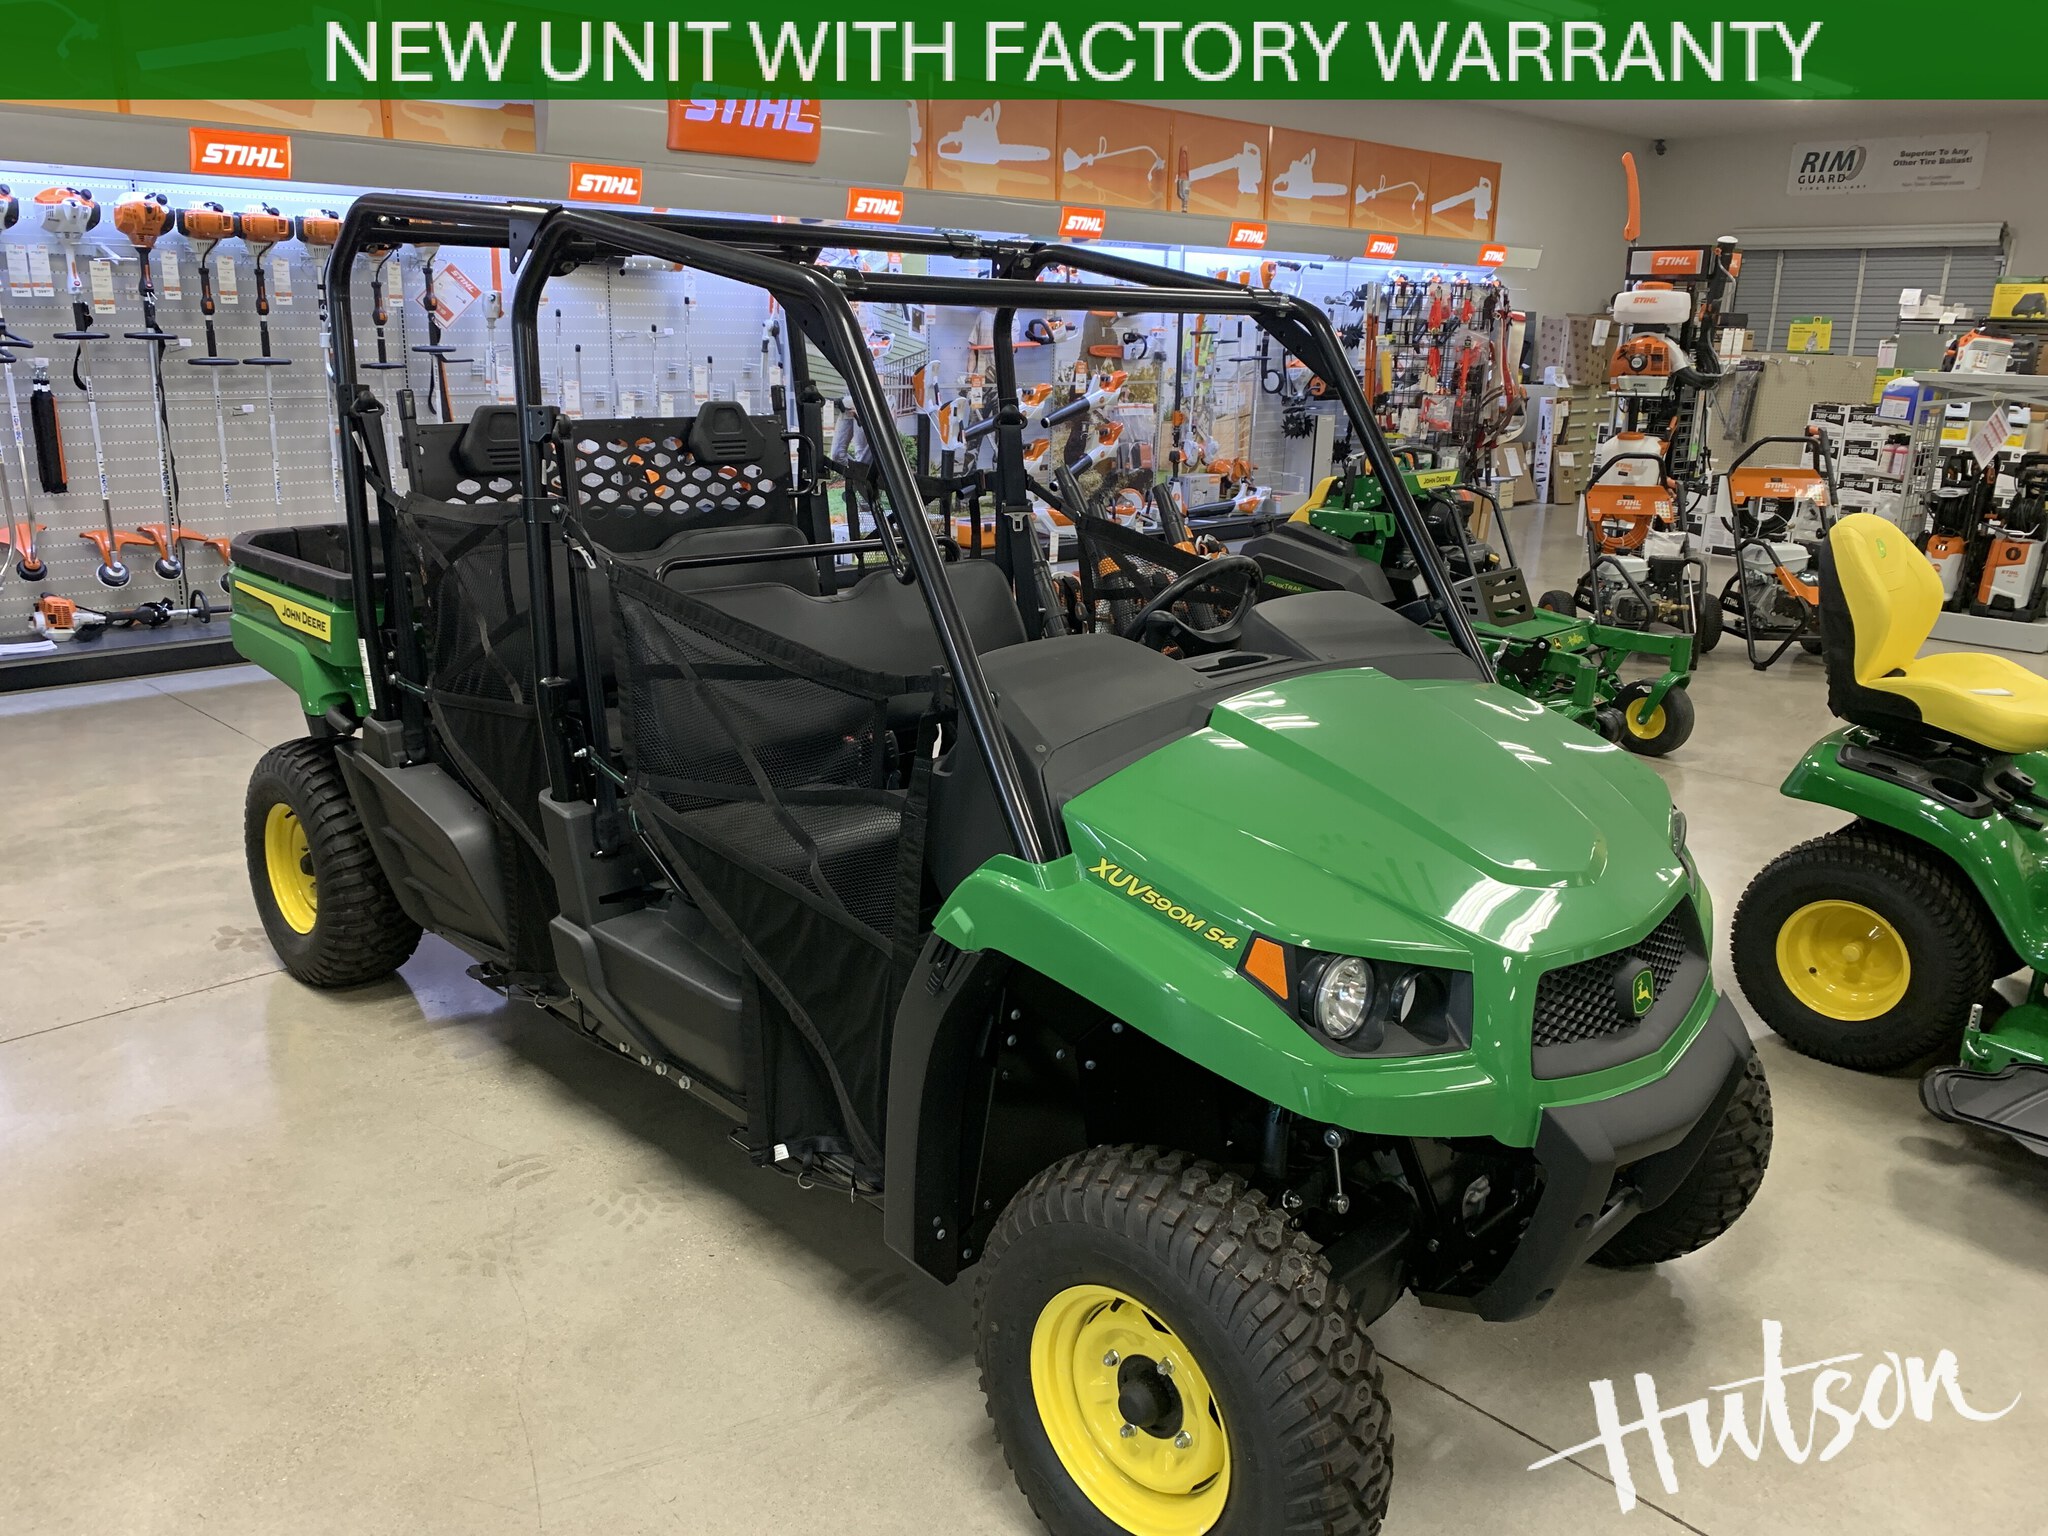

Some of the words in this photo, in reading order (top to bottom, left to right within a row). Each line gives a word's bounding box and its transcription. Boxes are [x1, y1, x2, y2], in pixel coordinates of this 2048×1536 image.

[685, 83, 815, 134] STIHL
[201, 143, 285, 169] STIHL
[1900, 150, 1937, 158] Superior
[1939, 148, 1950, 156] To
[1951, 148, 1969, 157] Any
[1800, 149, 1857, 173] RIM
[1893, 159, 1917, 167] Other
[1939, 156, 1973, 165] Ballast!
[577, 173, 638, 196] STIHL
[1798, 173, 1846, 185] GUARD
[854, 197, 900, 216] STIHL
[1065, 216, 1102, 231] STIHL
[1234, 229, 1265, 243] STIHL
[1370, 241, 1396, 254] STIHL
[1483, 250, 1505, 263] STIHL
[1656, 256, 1691, 266] STIHL
[451, 270, 475, 293] STIHL
[1815, 412, 1842, 420] TURF-GARD
[1848, 448, 1875, 456] TURF-GARD
[1424, 477, 1436, 485] JOHN
[1436, 475, 1451, 483] DEERE
[1881, 483, 1902, 491] TURF-GA
[282, 604, 301, 623] JOHN
[301, 611, 327, 633] DEERE
[1088, 856, 1207, 932] XUV590M
[1203, 926, 1240, 950] S4
